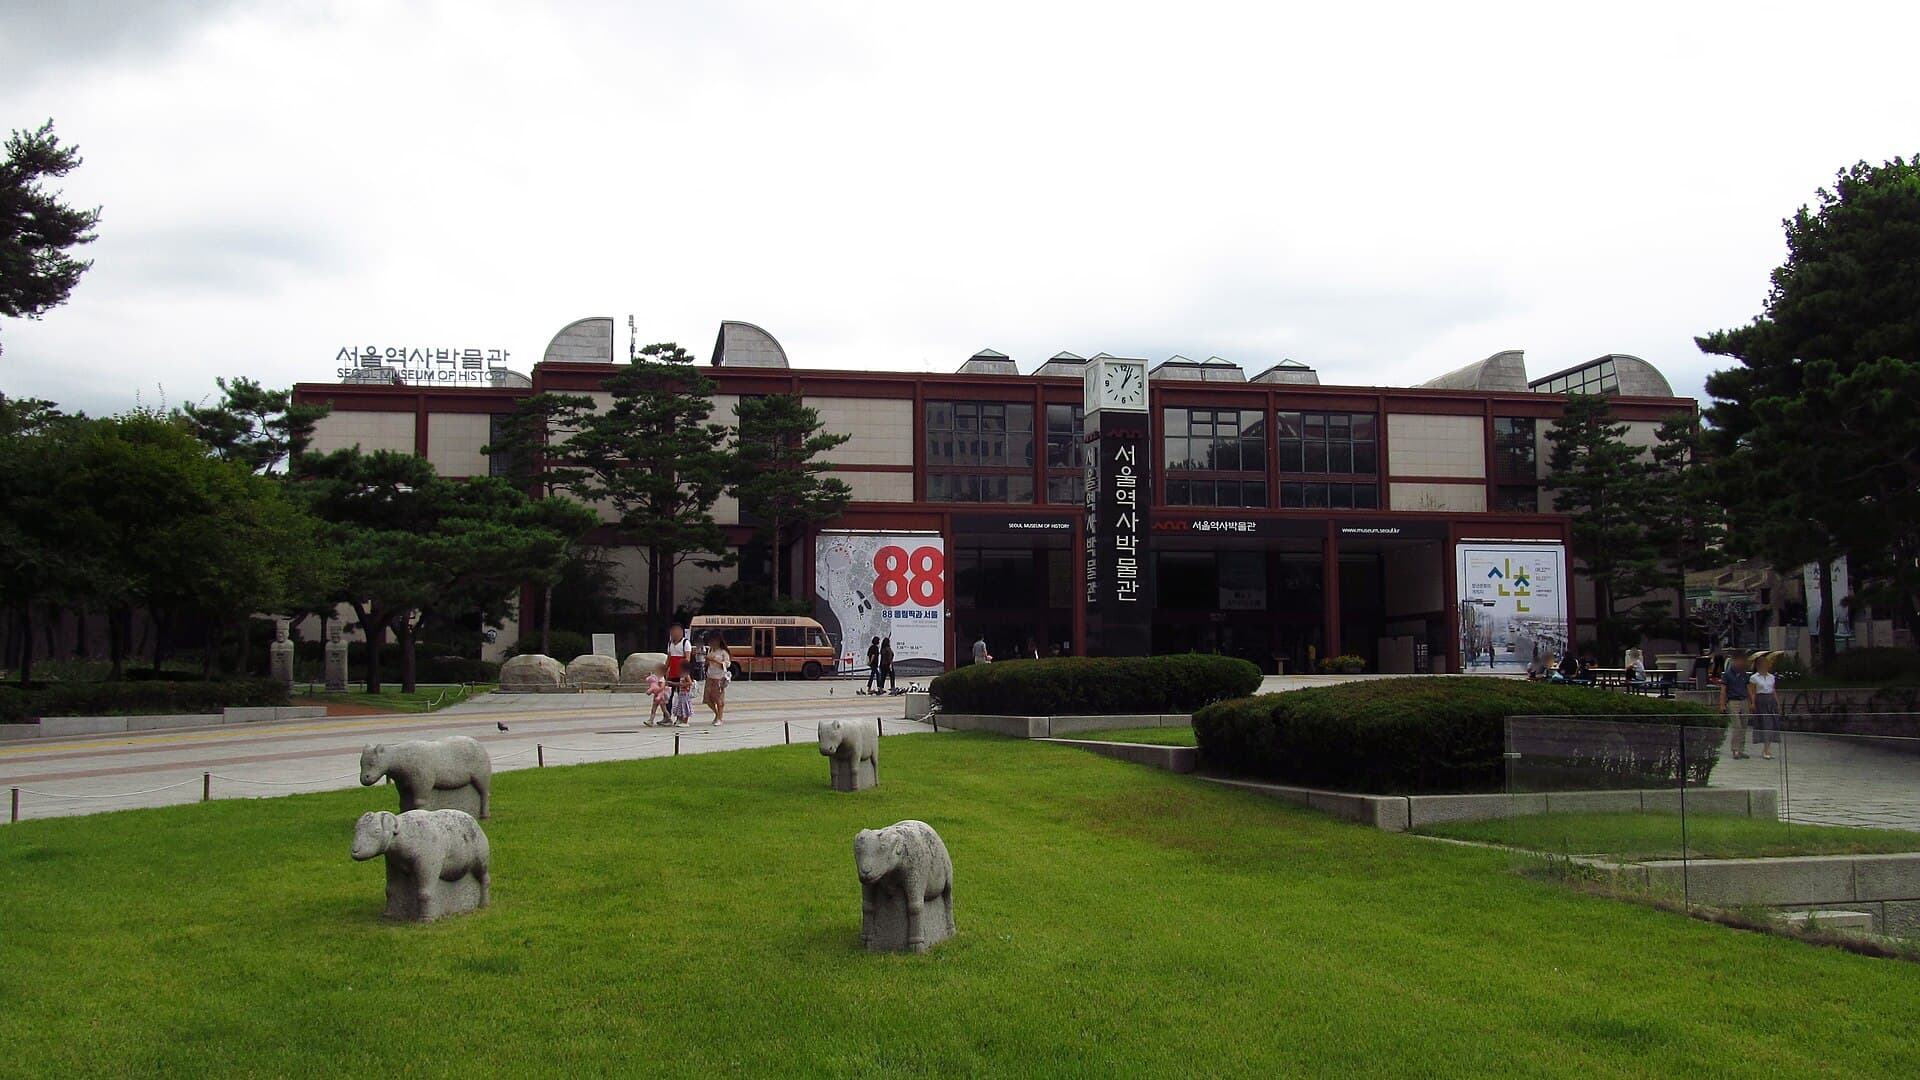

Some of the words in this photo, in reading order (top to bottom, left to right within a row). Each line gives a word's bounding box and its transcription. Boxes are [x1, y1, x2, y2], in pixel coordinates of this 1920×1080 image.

[336, 346, 510, 370] 서울역사박물관
[337, 368, 376, 379] SEOUL
[380, 369, 434, 380] MUSEUM
[438, 370, 456, 381] OF
[1137, 381, 1143, 389] 3
[1114, 444, 1139, 602] 서울역사박물관
[1192, 520, 1257, 532] 서울역사박물관
[872, 545, 944, 607] 88
[882, 610, 893, 618] 88
[924, 610, 938, 619] 서울
